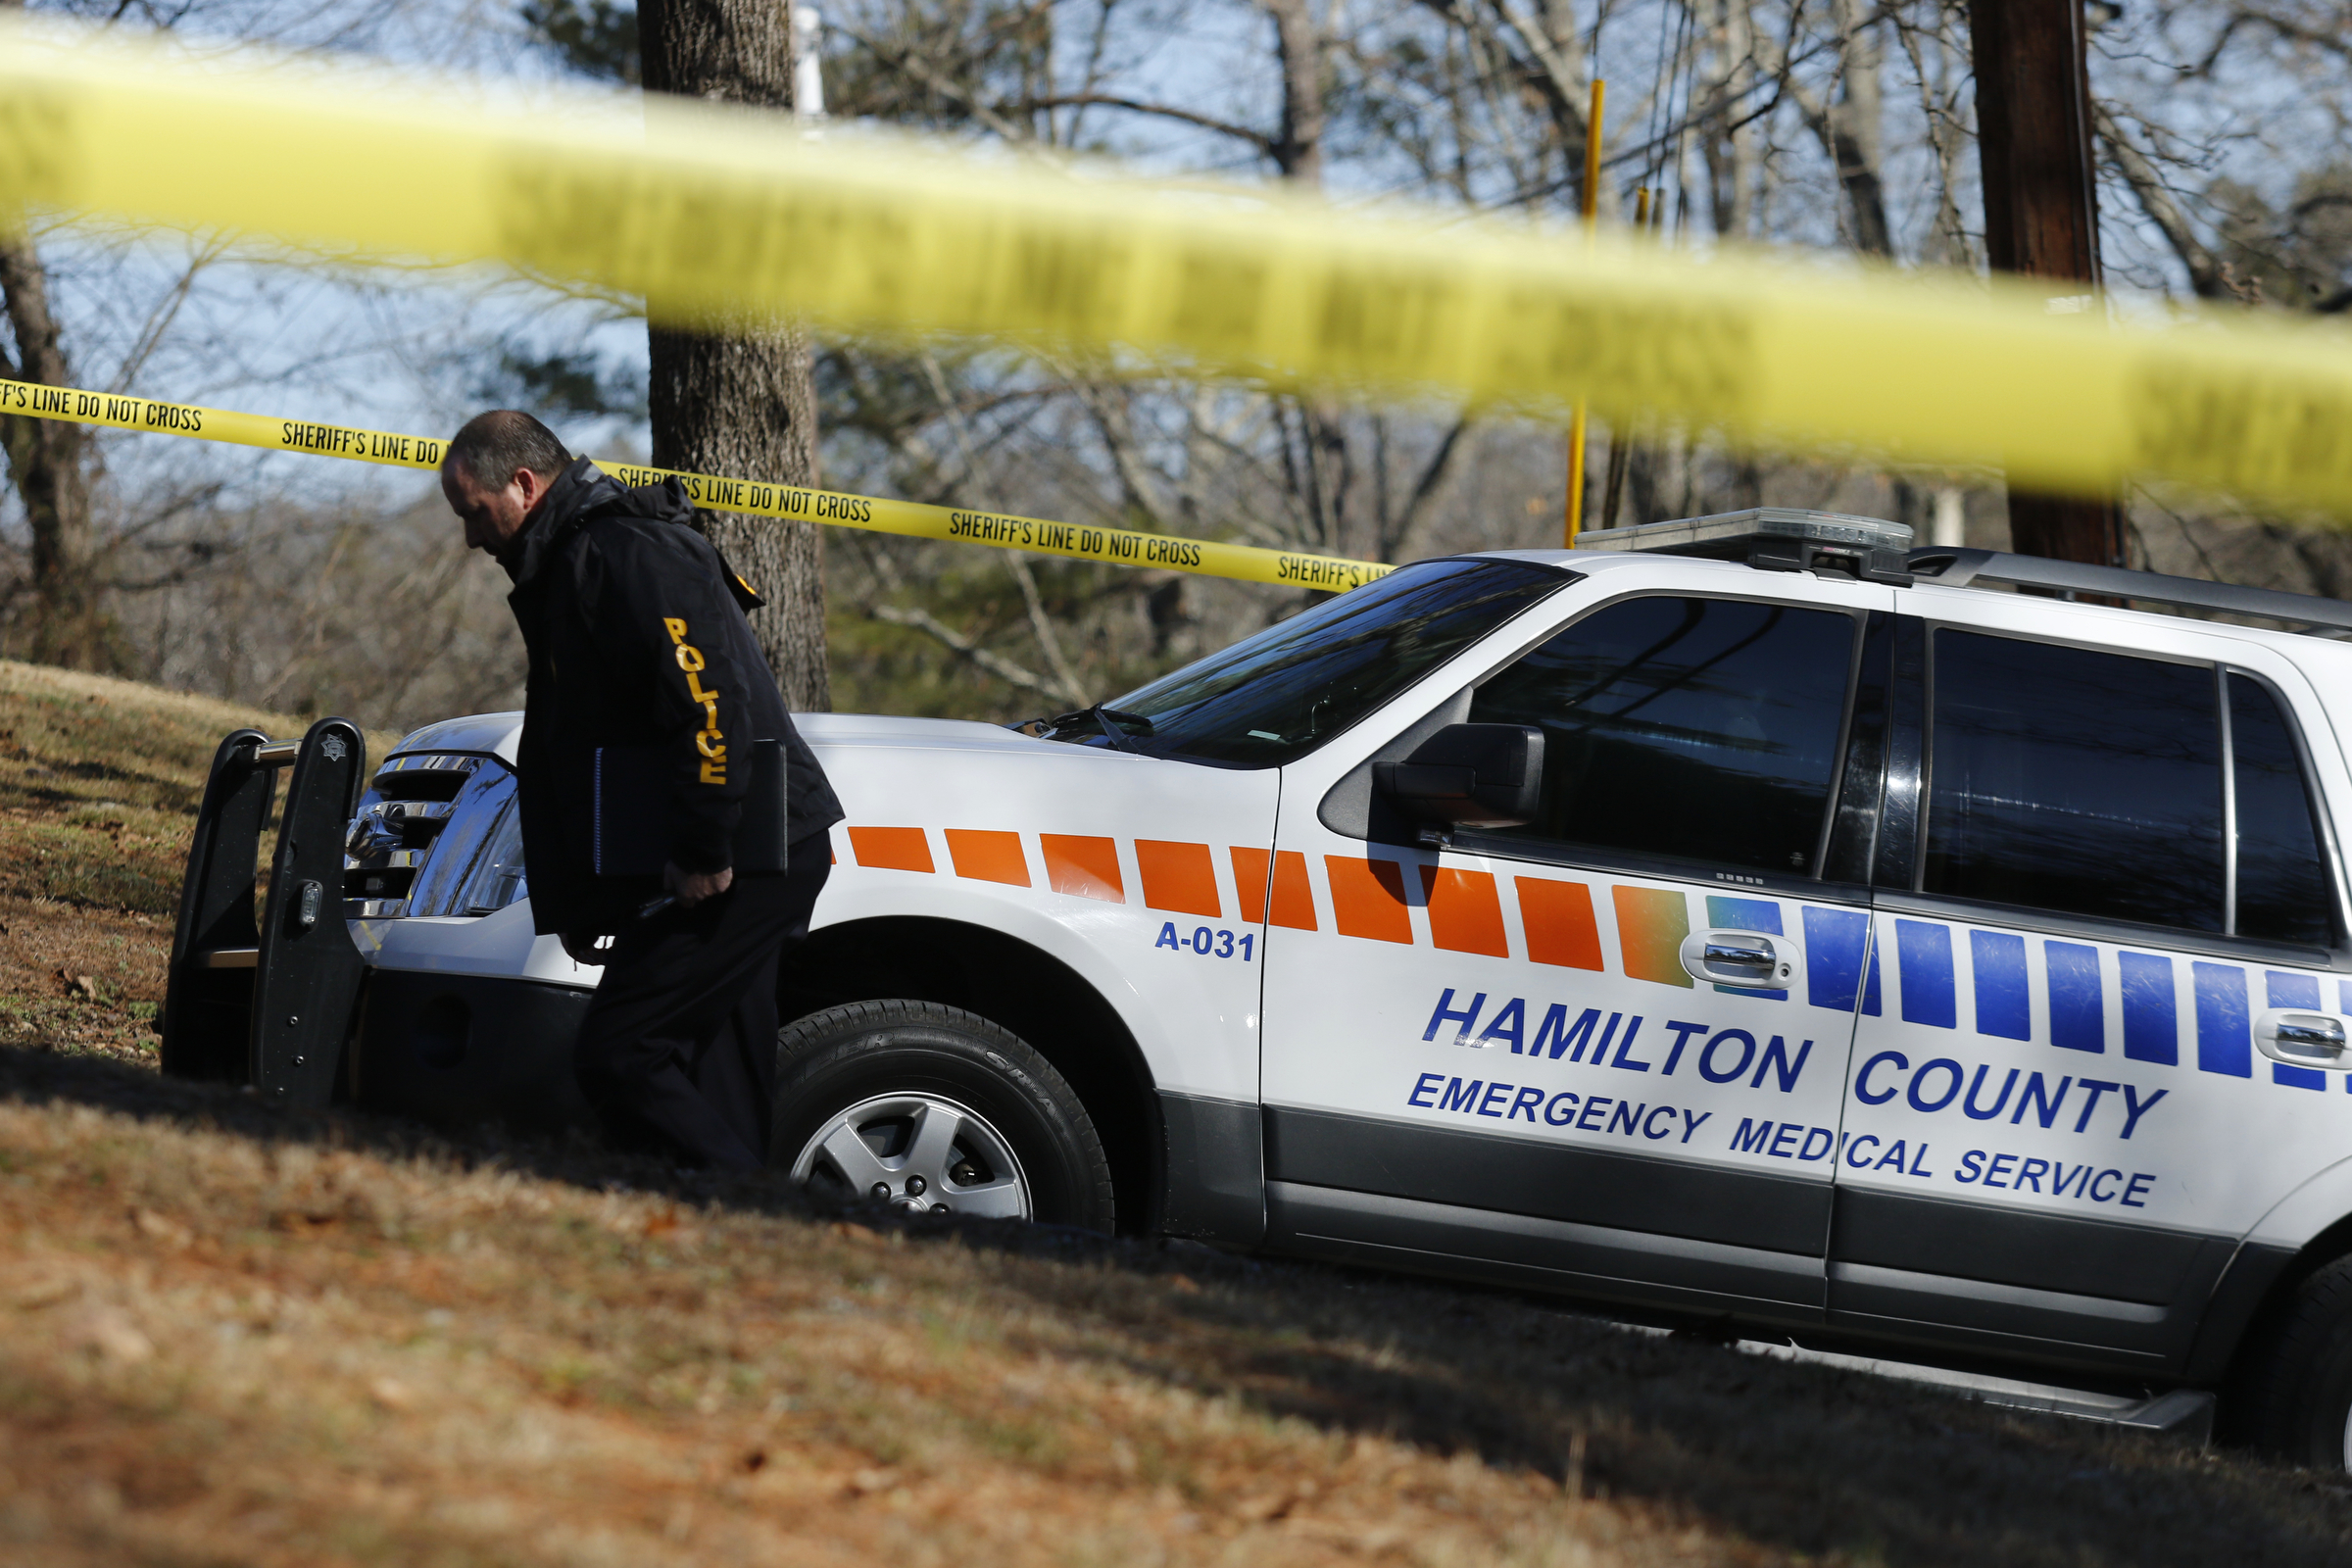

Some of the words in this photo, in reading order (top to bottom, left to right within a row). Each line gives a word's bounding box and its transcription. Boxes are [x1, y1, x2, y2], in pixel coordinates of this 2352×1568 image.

[32, 388, 71, 415] LINE
[76, 394, 100, 417] DO
[106, 398, 141, 423] NOT
[146, 404, 202, 431] CROSS
[282, 422, 367, 455] SHERIFF'S
[371, 434, 411, 461] LINE
[416, 440, 439, 464] DO
[707, 479, 744, 507] LINE
[750, 485, 772, 510] DO
[778, 489, 811, 514] NOT
[816, 494, 871, 522] CROSS
[950, 513, 1032, 544] SHERIFF'S
[1038, 523, 1075, 551] LINE
[1080, 529, 1103, 554] DO
[1109, 533, 1143, 559] NOT
[1147, 538, 1200, 566] CROSS
[1278, 556, 1359, 589] SHERIFF'S
[662, 617, 727, 785] POLICE
[1154, 921, 1254, 962] A-031
[1421, 988, 1814, 1094] HAMILTON
[1853, 1051, 2170, 1140] COUNTY
[1407, 1072, 1712, 1144] EMERGENCY
[1729, 1117, 1933, 1178] MEDICAL
[1953, 1150, 2156, 1208] SERVICE
